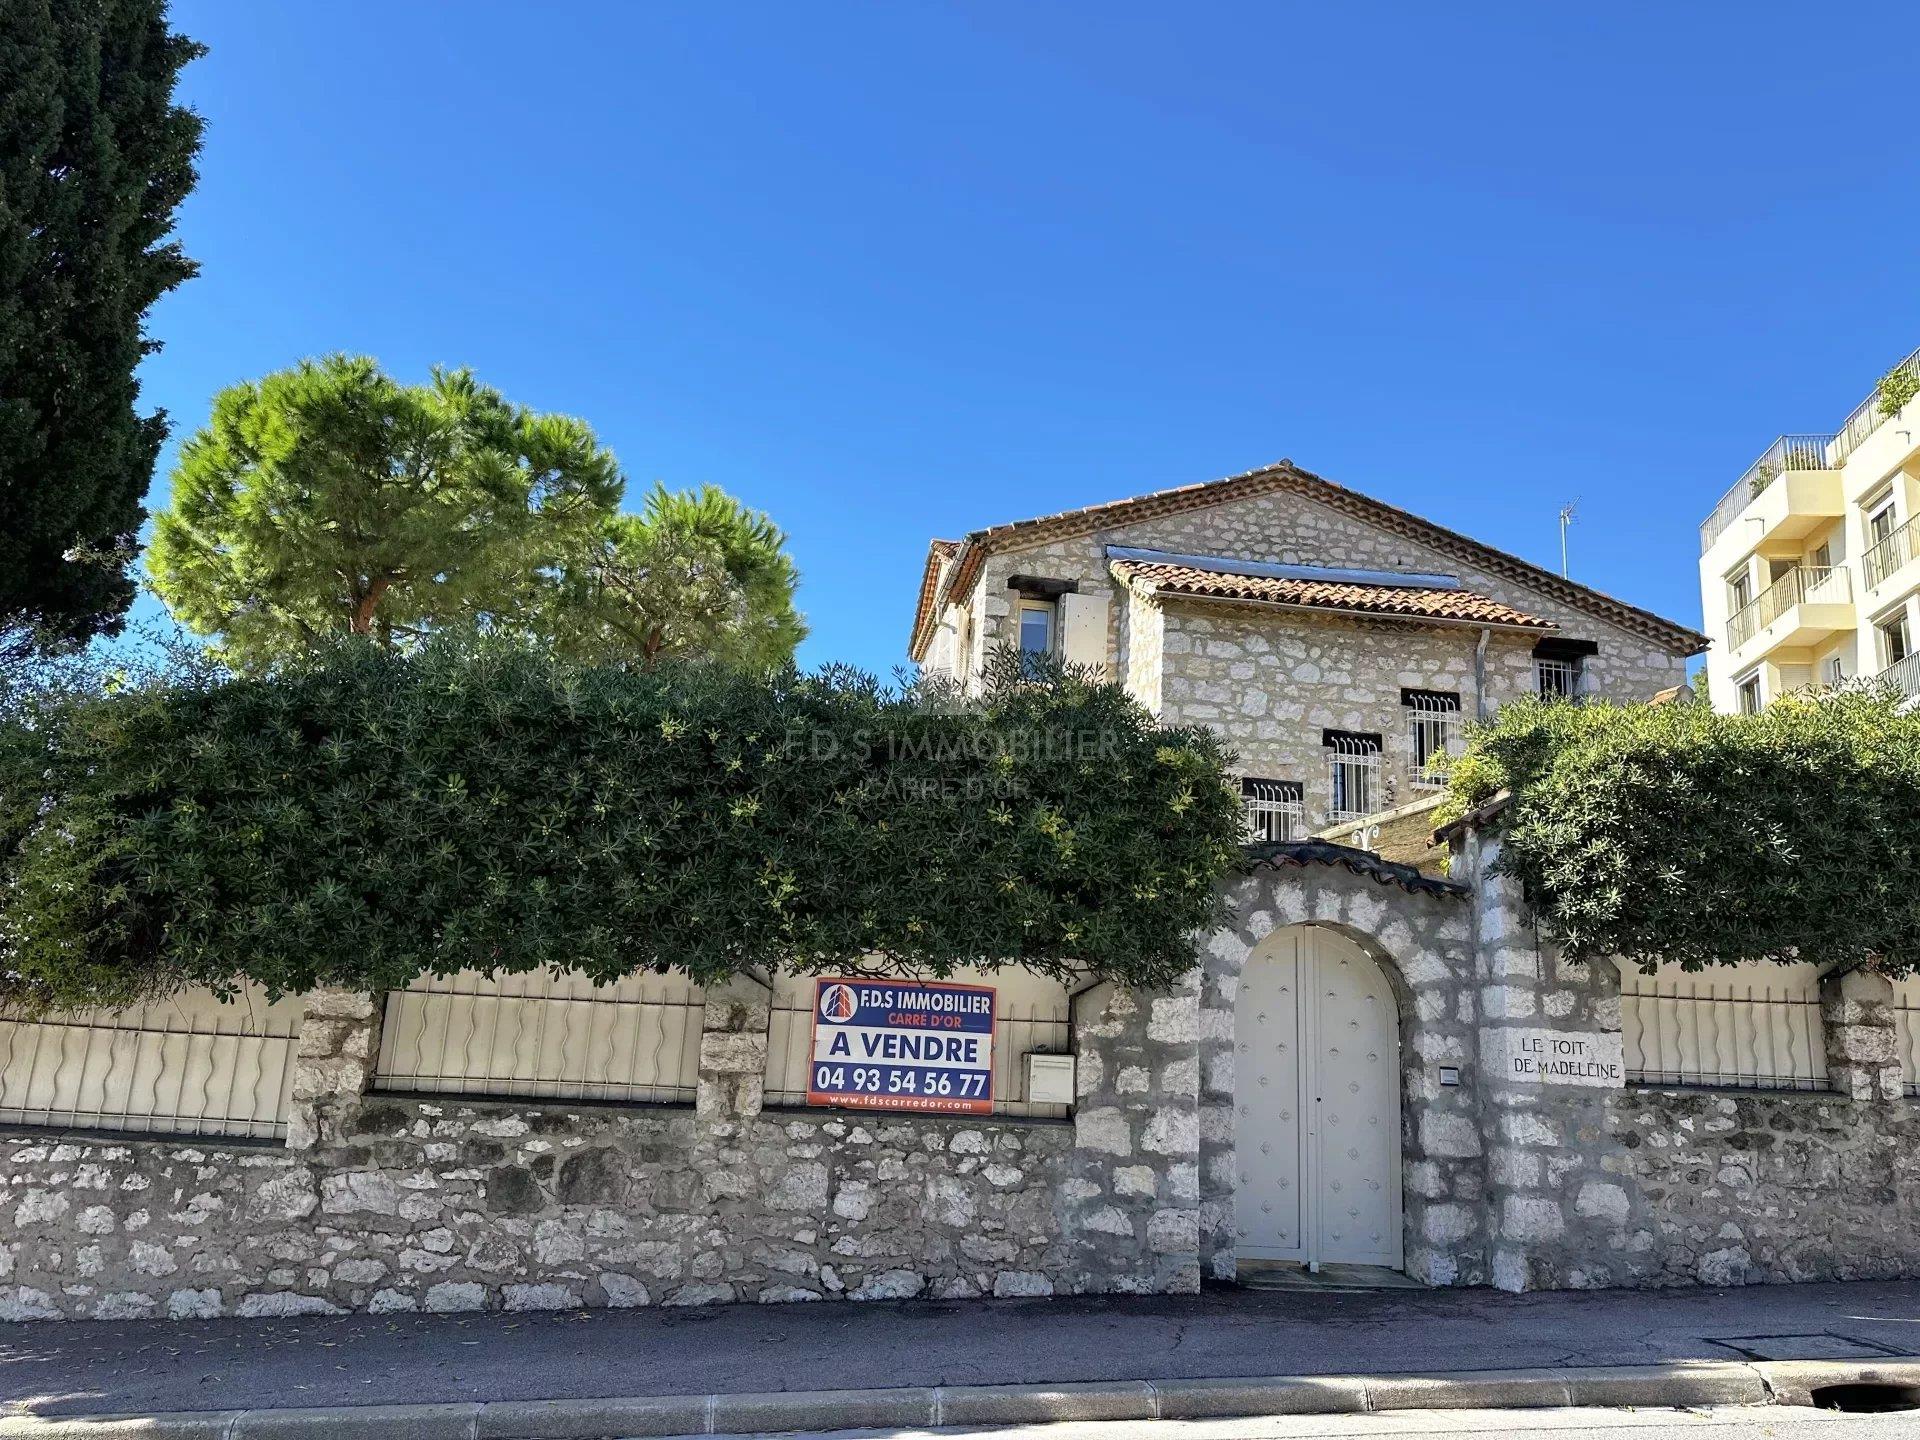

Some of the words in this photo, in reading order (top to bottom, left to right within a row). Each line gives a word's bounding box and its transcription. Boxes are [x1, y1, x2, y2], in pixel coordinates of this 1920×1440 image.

[860, 989, 893, 1008] F.D.S
[897, 991, 990, 1014] IMMOBILIER
[888, 1011, 927, 1026] CARRÉ
[931, 1013, 962, 1028] D'OR
[829, 1031, 851, 1056] A
[861, 1032, 978, 1063] VENDRE
[1521, 1037, 1544, 1053] LE
[1552, 1040, 1588, 1055] TOIT
[1514, 1058, 1534, 1073] DE
[1538, 1060, 1620, 1080] MADELEINE
[817, 1066, 845, 1090] 04
[853, 1068, 880, 1092] 93
[888, 1070, 916, 1093] 54
[924, 1072, 951, 1095] 56
[959, 1074, 987, 1097] 77
[829, 1096, 972, 1110] www.fdscarredor.com
